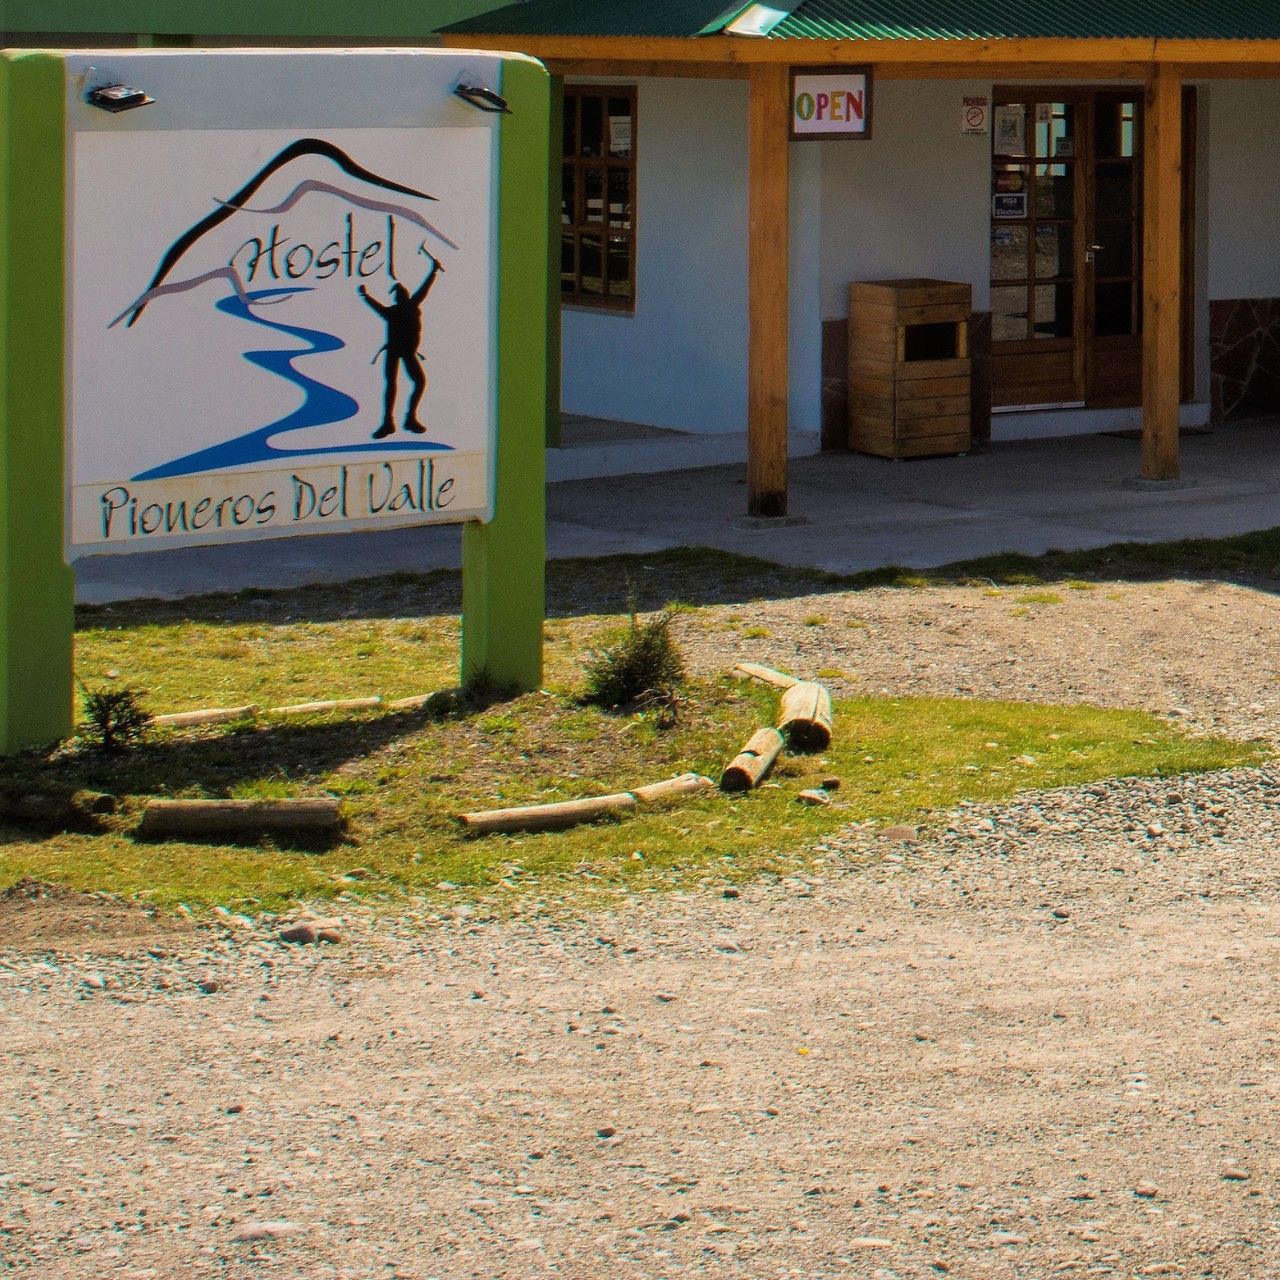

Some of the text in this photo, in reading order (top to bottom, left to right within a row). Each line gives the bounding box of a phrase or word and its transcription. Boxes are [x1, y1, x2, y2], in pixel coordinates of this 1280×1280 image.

[795, 89, 864, 122] OPEN
[228, 211, 398, 282] Hostel
[99, 458, 458, 539] Pioneros Del Valle
